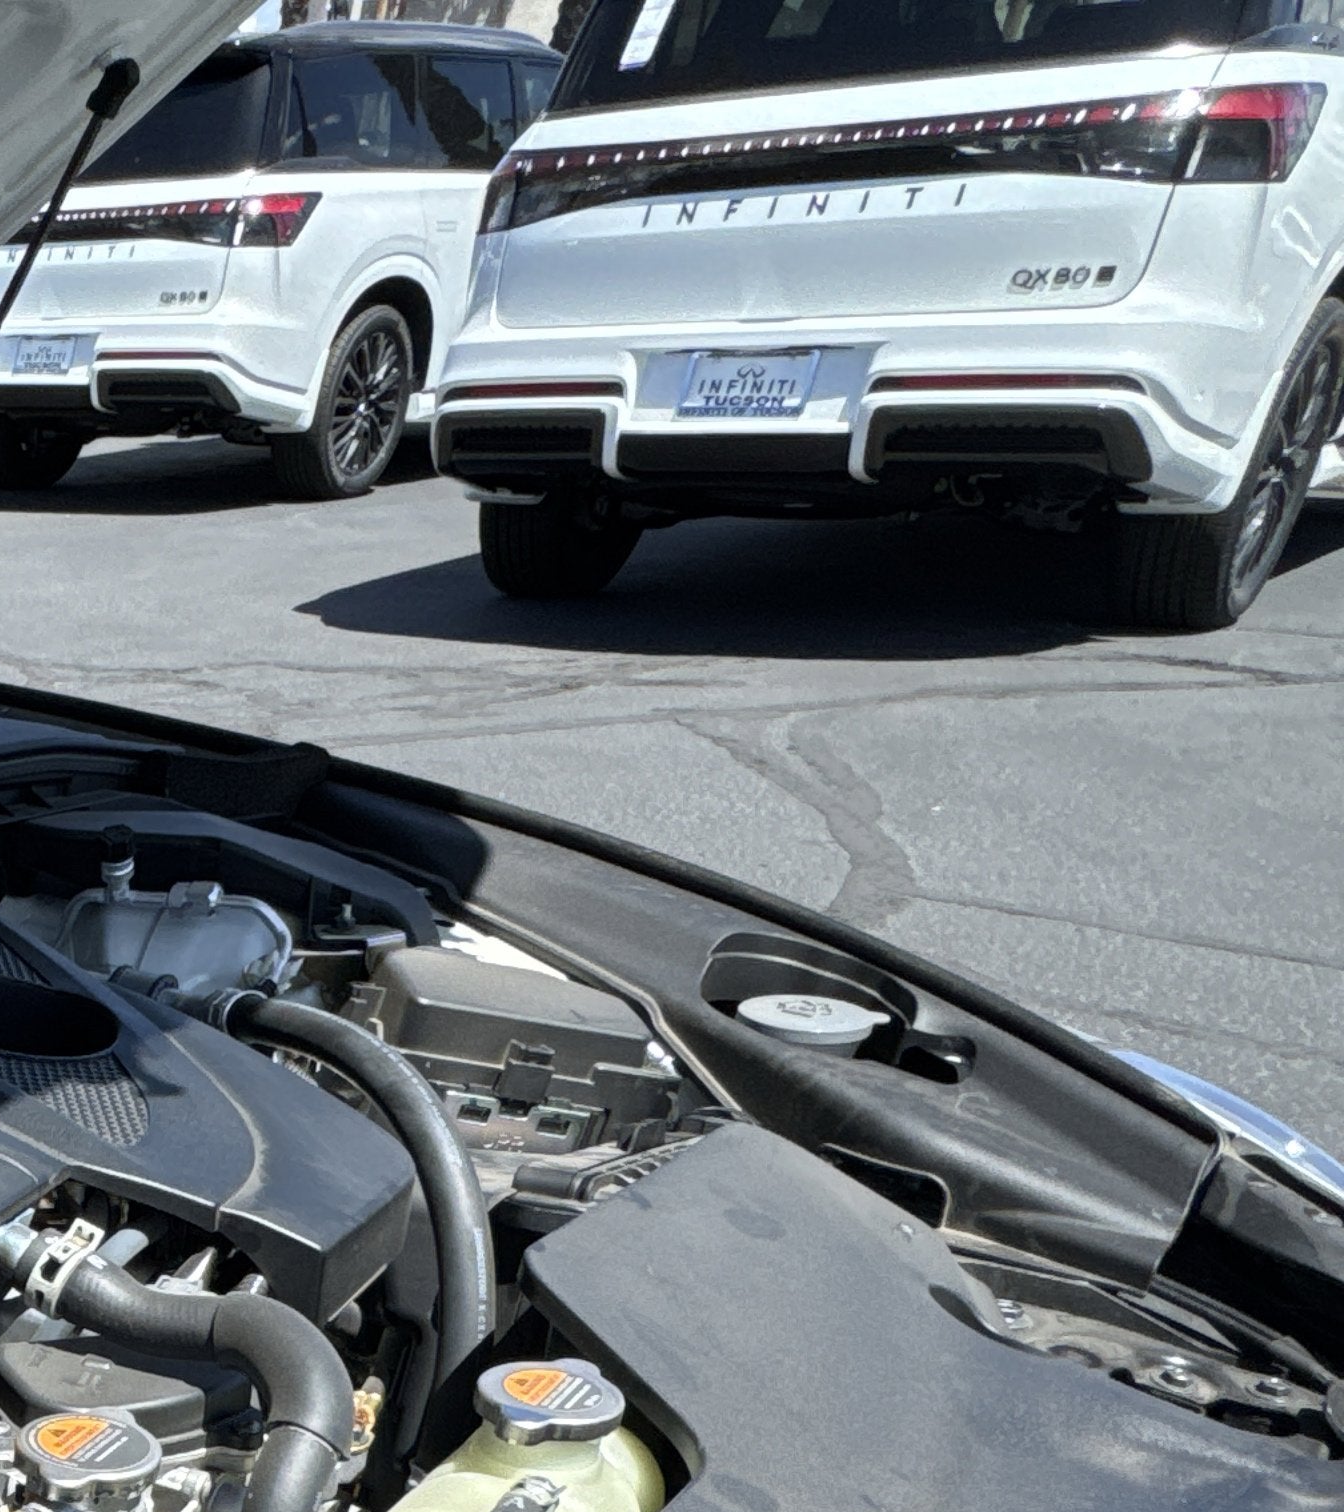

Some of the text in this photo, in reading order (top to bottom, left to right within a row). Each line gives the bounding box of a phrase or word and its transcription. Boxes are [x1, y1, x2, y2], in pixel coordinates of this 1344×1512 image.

[643, 183, 967, 227] INFINITI
[1011, 267, 1090, 289] QX80
[698, 379, 796, 394] INFINITI
[703, 395, 785, 406] TUCSON
